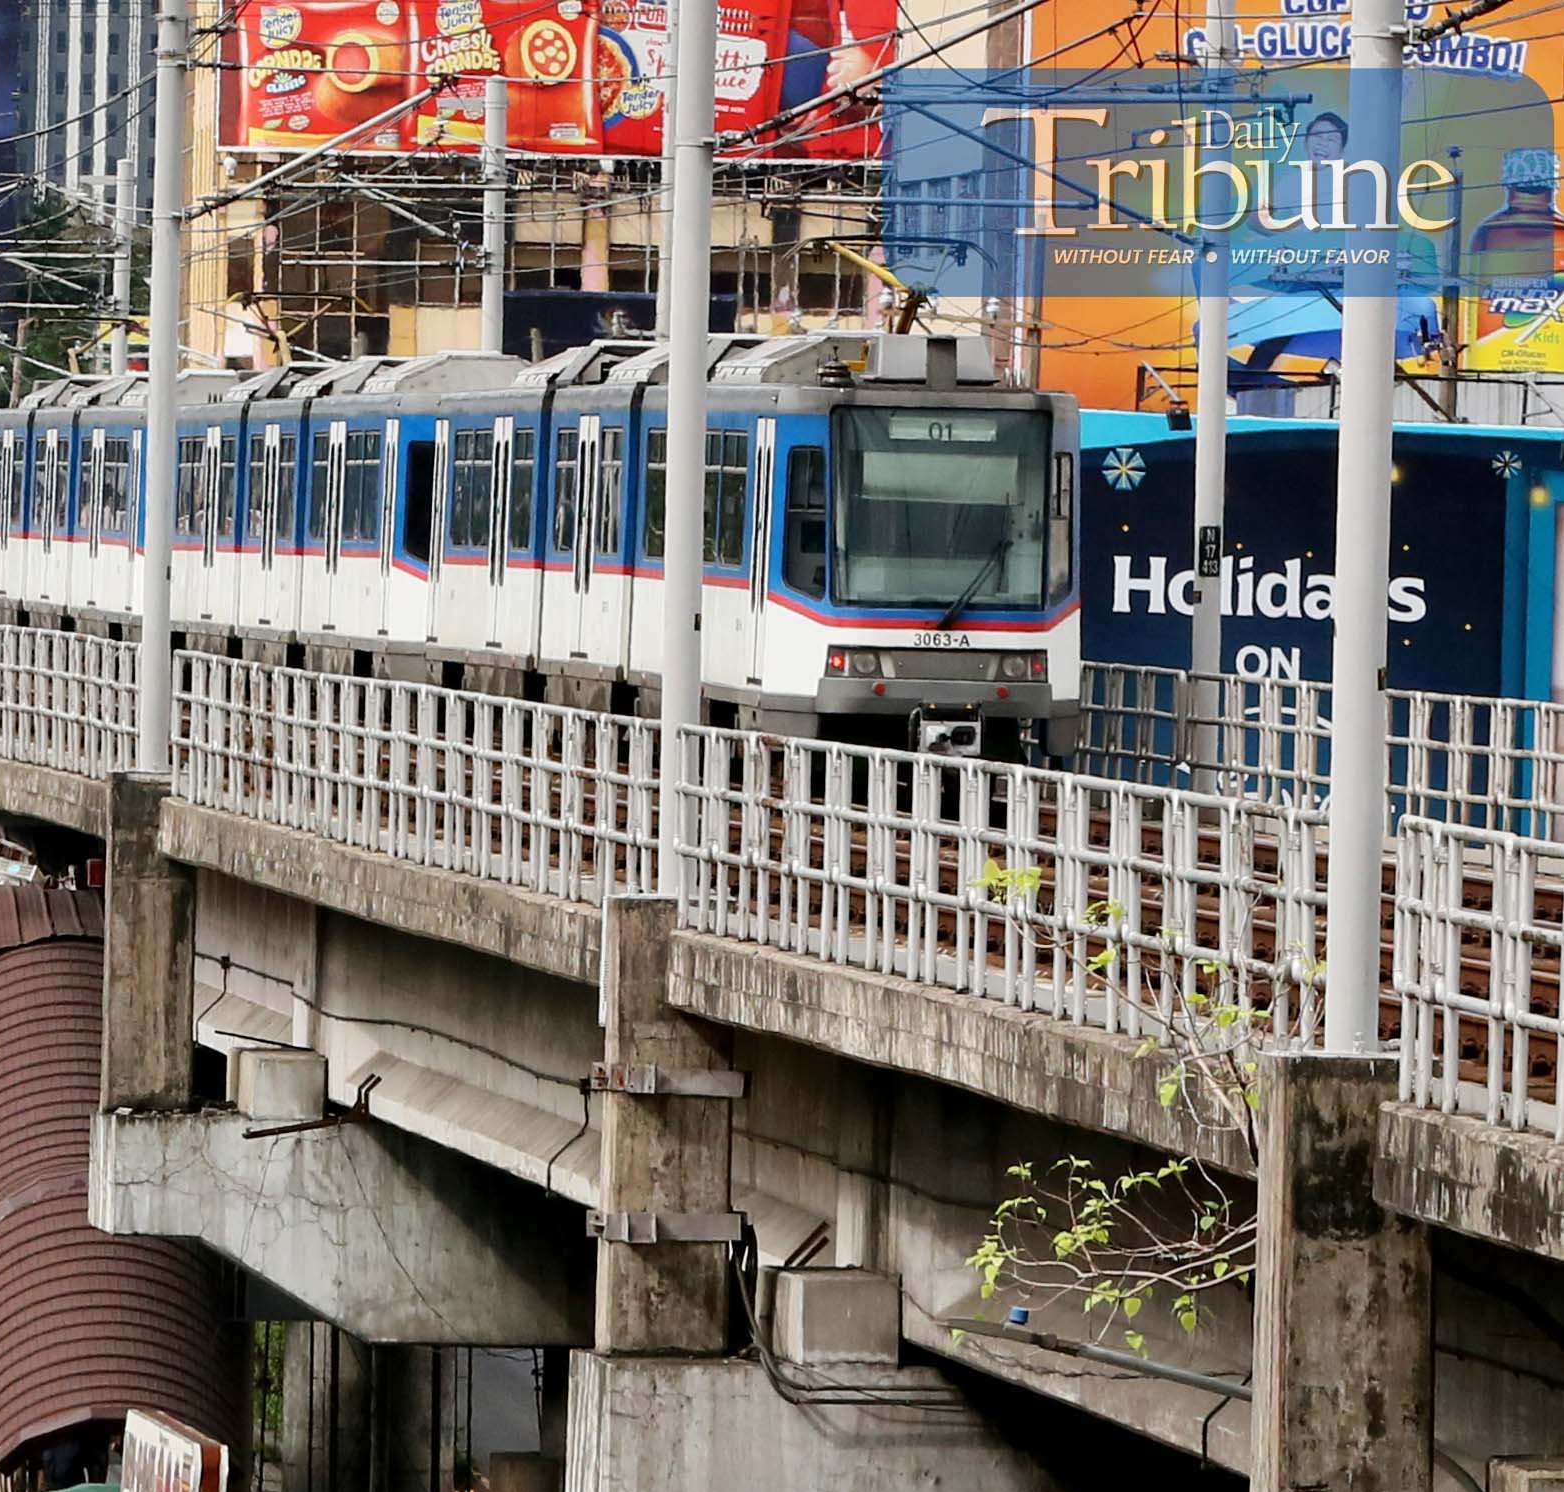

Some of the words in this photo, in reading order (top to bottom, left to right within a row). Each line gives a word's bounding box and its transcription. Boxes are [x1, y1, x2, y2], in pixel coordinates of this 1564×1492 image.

[928, 422, 954, 441] 01
[1206, 528, 1216, 542] N
[1205, 543, 1215, 558] 17
[1113, 553, 1427, 623] Holidas
[914, 634, 970, 648] 3063-A
[1235, 645, 1301, 680] ON
